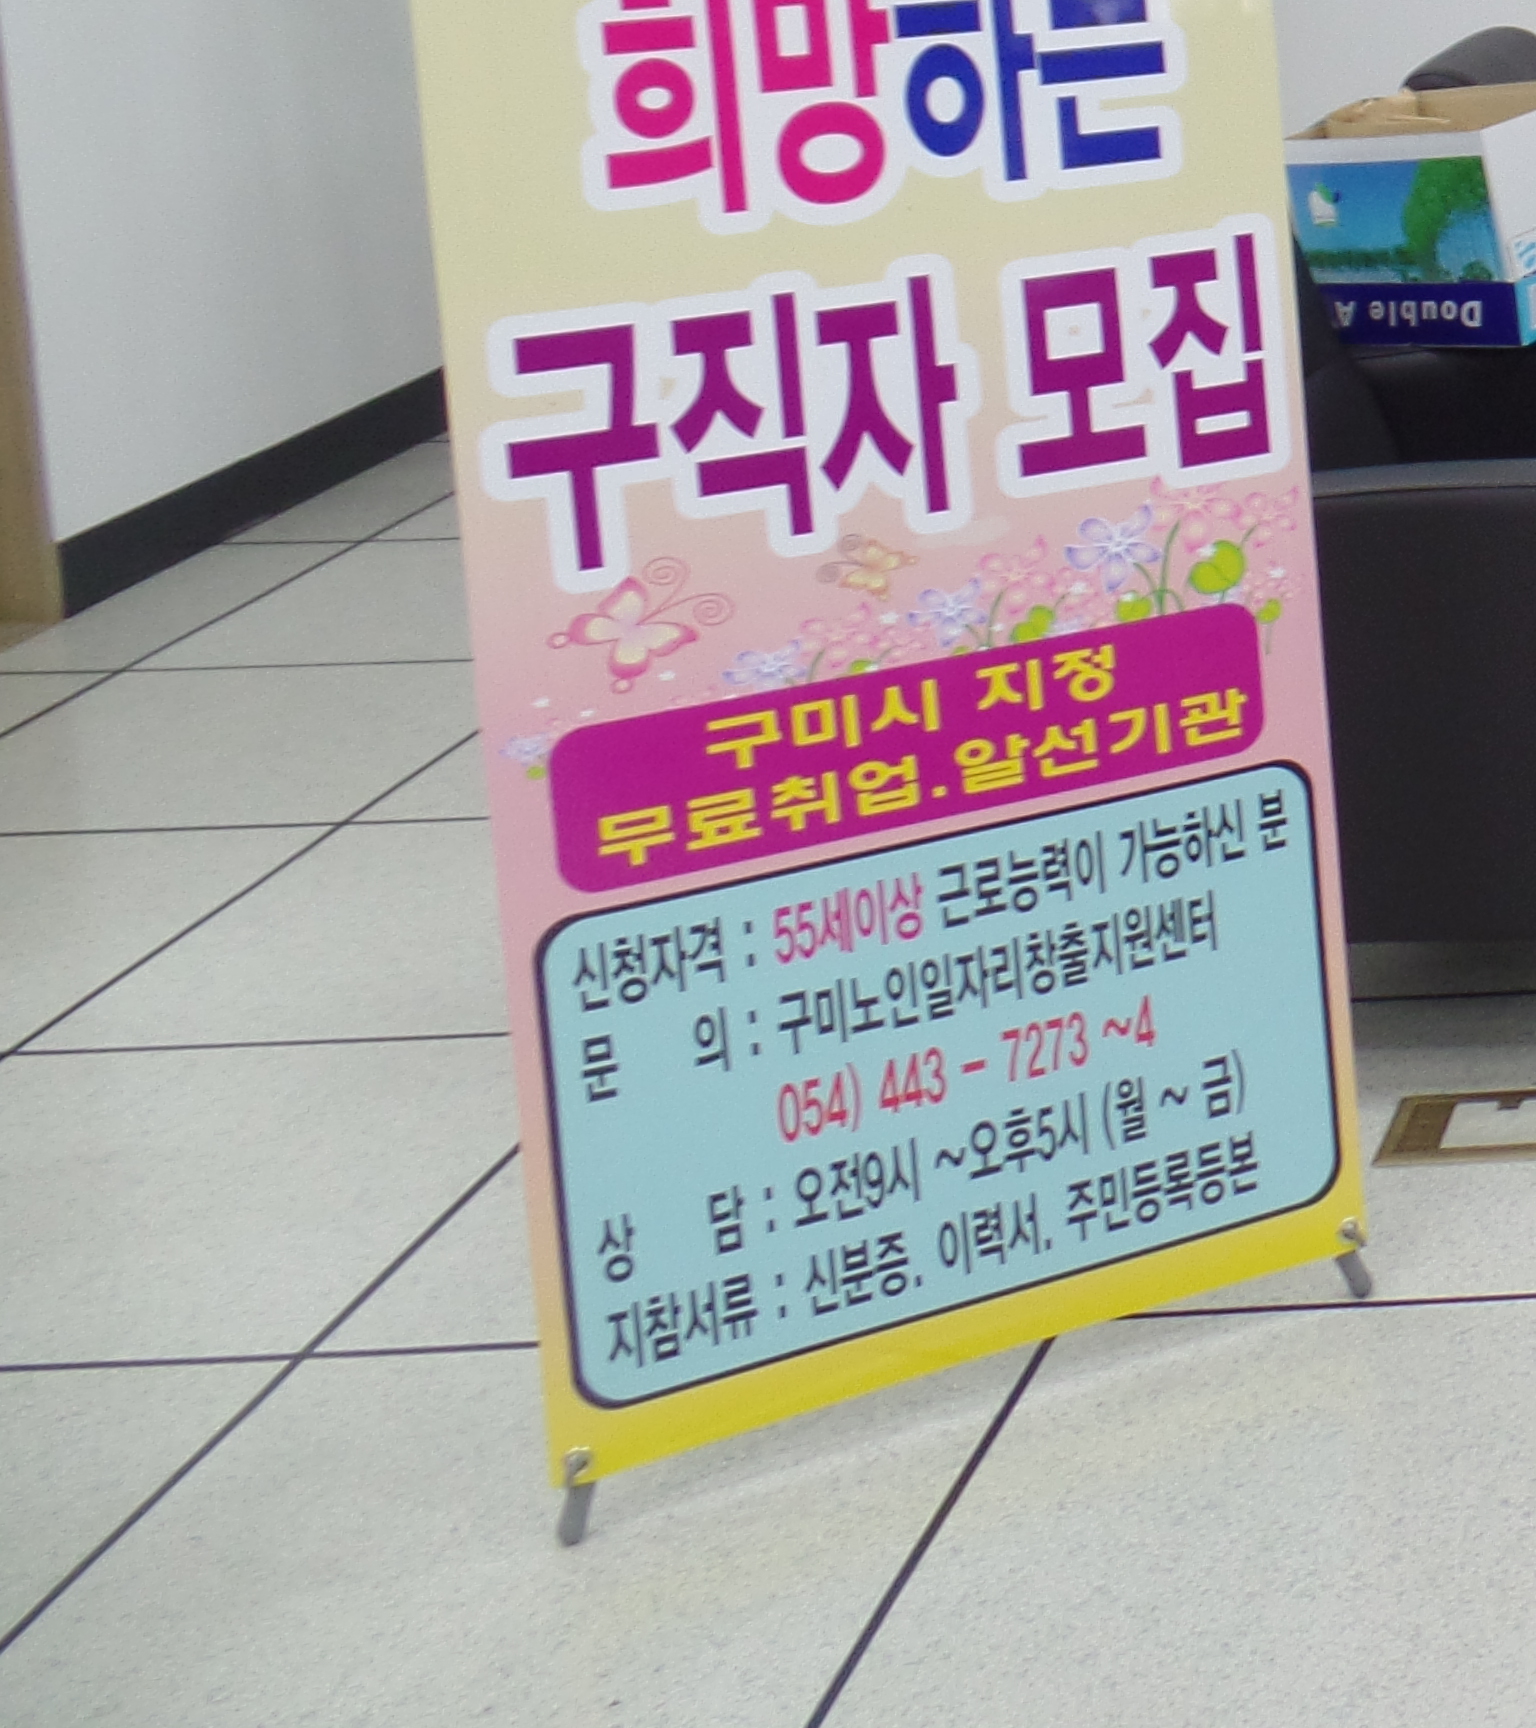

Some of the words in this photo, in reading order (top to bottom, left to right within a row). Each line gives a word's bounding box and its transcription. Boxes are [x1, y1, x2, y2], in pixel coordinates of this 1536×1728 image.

[1369, 300, 1483, 328] Double
[505, 273, 959, 572] 구직자
[1017, 233, 1271, 478] 모집
[706, 679, 940, 769] 구미시
[976, 644, 1116, 712] 지정
[573, 917, 727, 1013] 신청자격
[773, 872, 925, 965] 55세이상
[936, 829, 1107, 929] 근로능력이
[1119, 798, 1246, 884] 가능하신
[1258, 789, 1288, 852] 분
[777, 889, 1218, 1056] 구미노인일자리창출지원센터
[777, 1061, 862, 1144] 054)
[879, 1046, 949, 1114] 443
[1000, 1010, 1091, 1084] 7273
[606, 1272, 758, 1368] 지참서류
[1066, 1130, 1258, 1242] 주민등록등본
[795, 1137, 922, 1227] 오전9시
